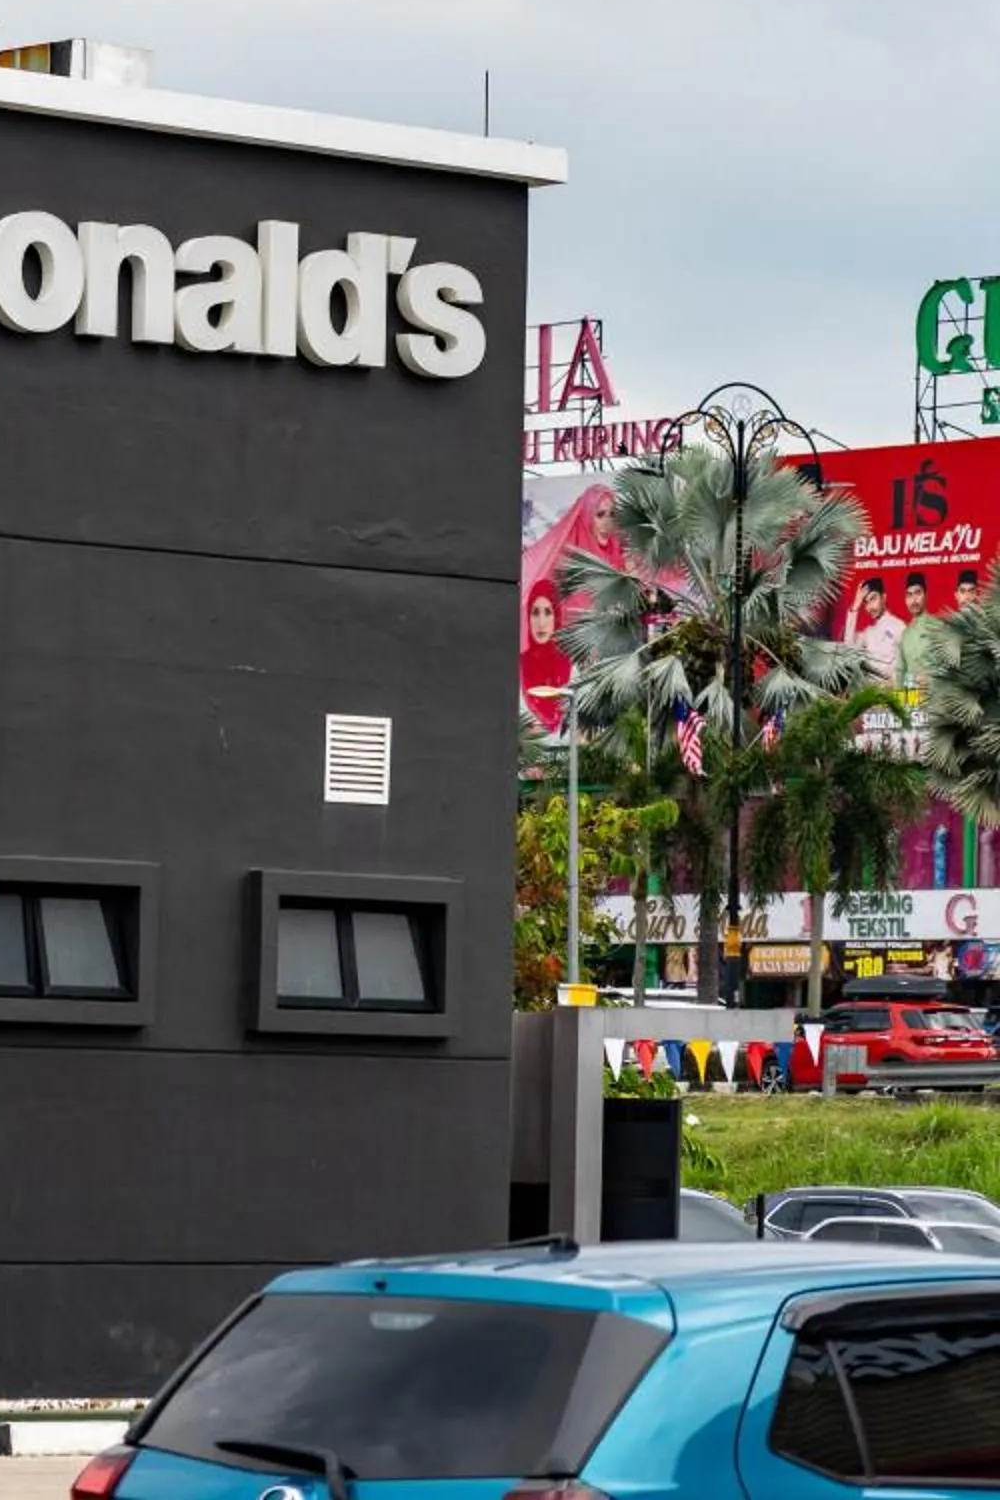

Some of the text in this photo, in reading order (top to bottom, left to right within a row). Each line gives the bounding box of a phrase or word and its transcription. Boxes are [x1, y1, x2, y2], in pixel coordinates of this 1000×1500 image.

[554, 418, 682, 462] KURUNG
[854, 523, 982, 557] BAJU MELAYU
[850, 893, 913, 916] GEDUNG
[848, 917, 910, 938] TEKSTIL
